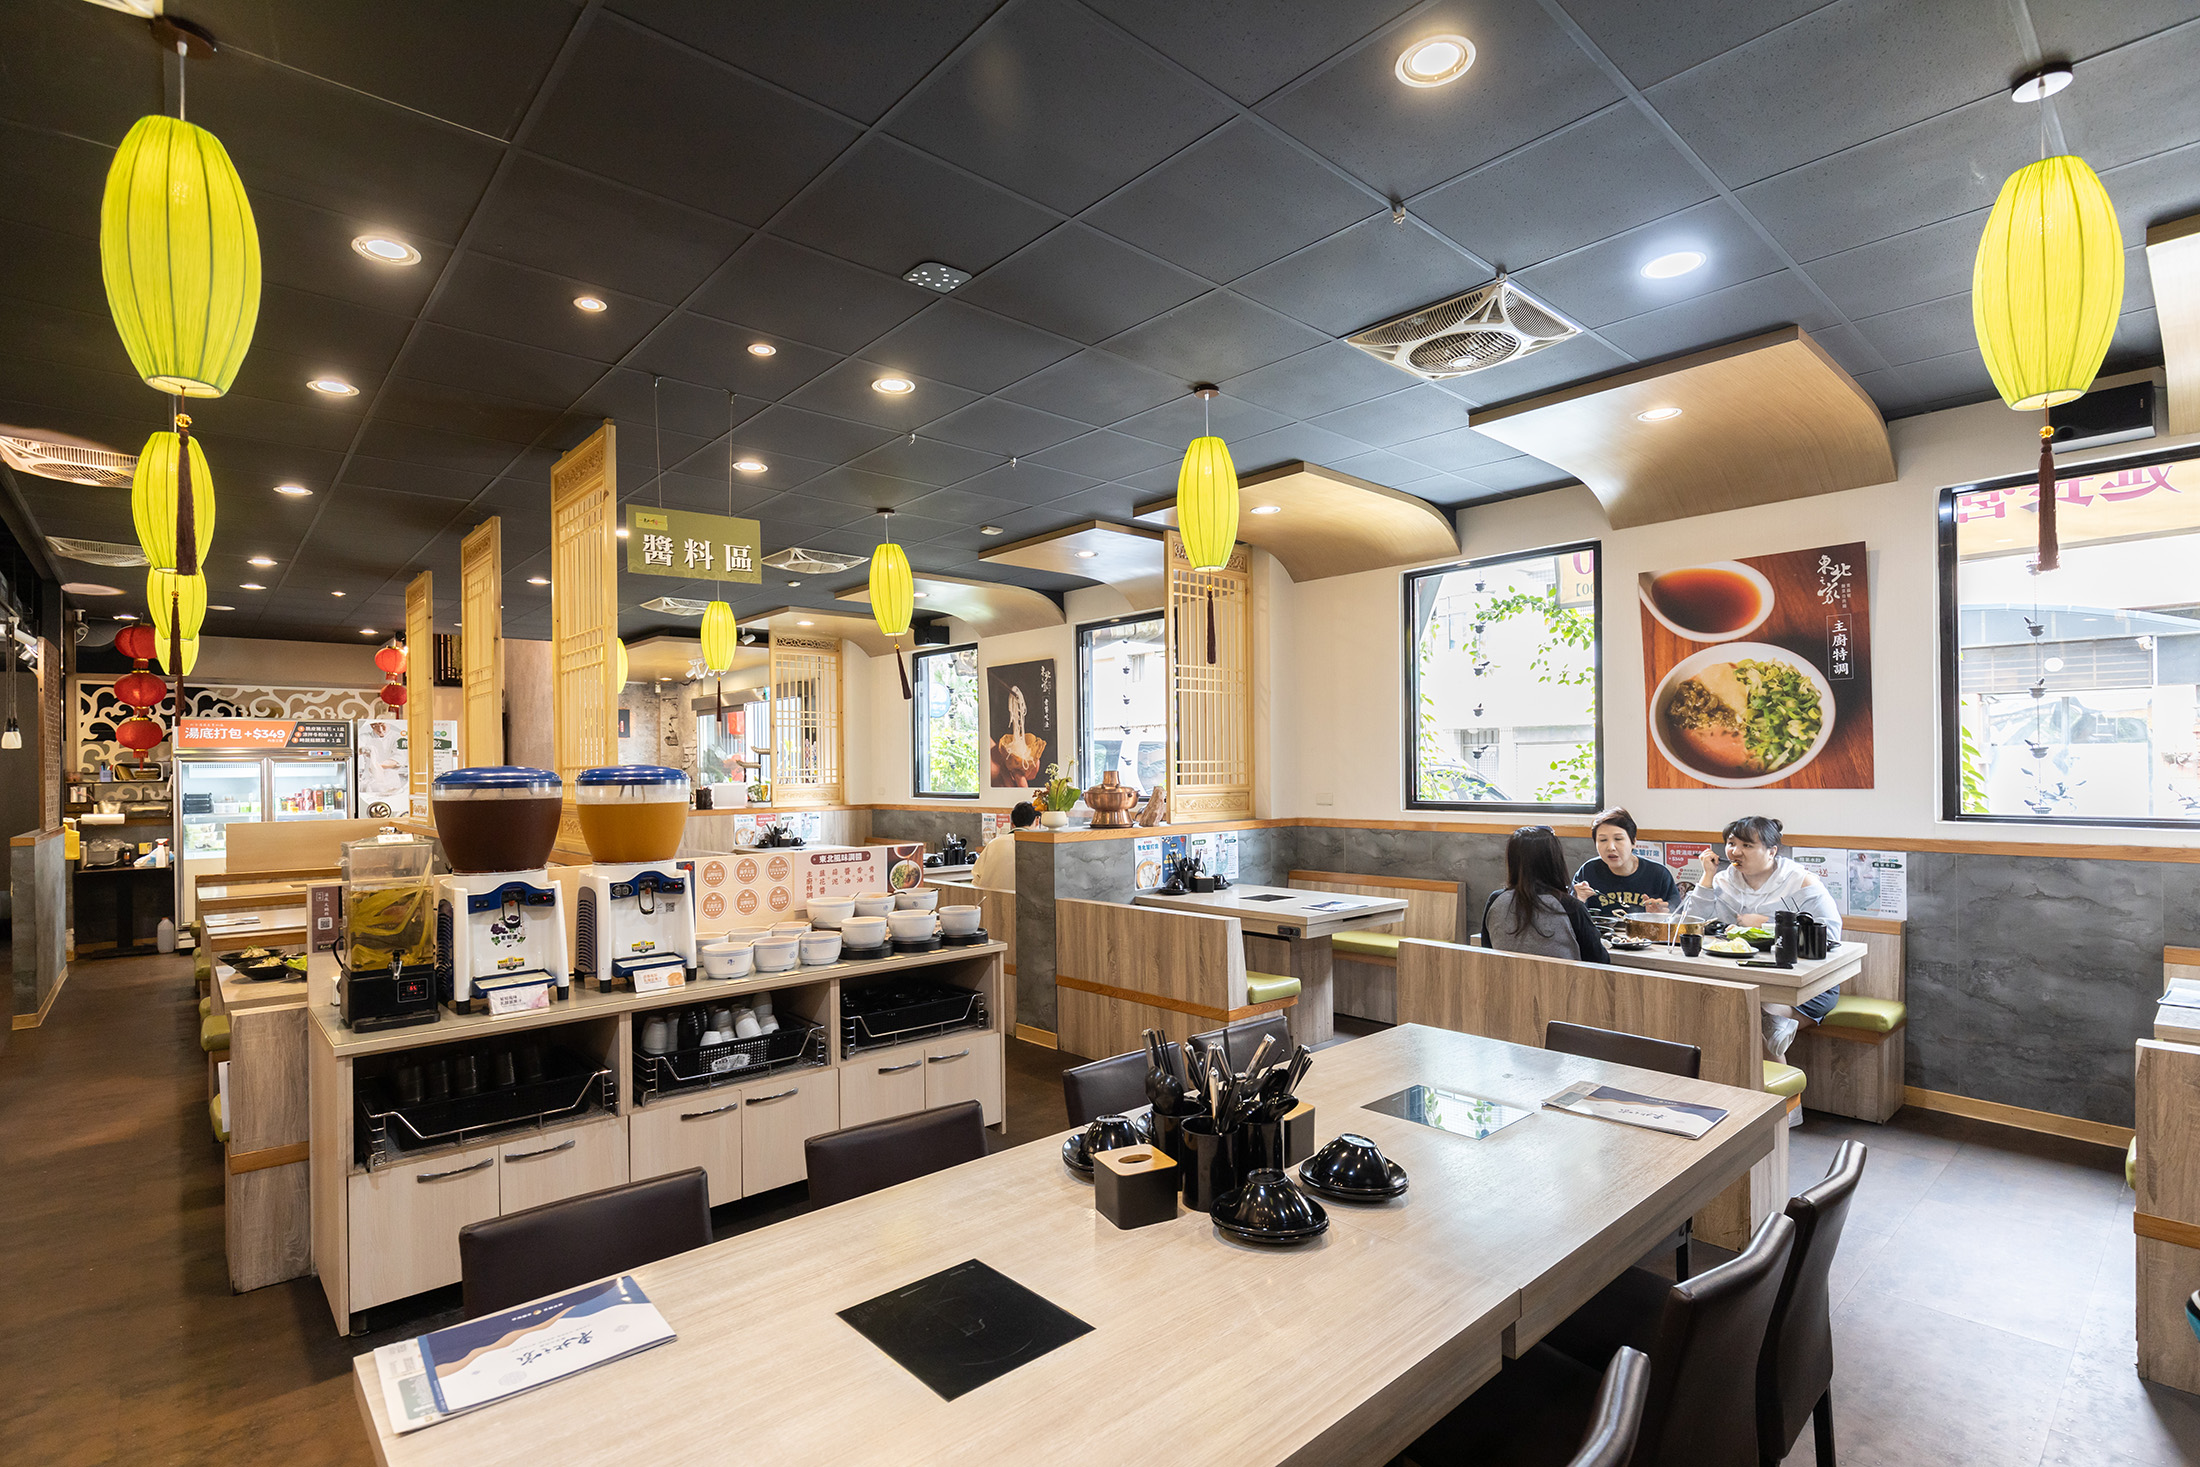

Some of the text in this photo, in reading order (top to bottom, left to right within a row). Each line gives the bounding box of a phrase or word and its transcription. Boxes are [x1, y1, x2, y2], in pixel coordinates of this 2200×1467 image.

[642, 533, 753, 573] 醬料區
[1831, 620, 1849, 676] 主廚特調
[184, 727, 286, 740] 湯底打包 +$349
